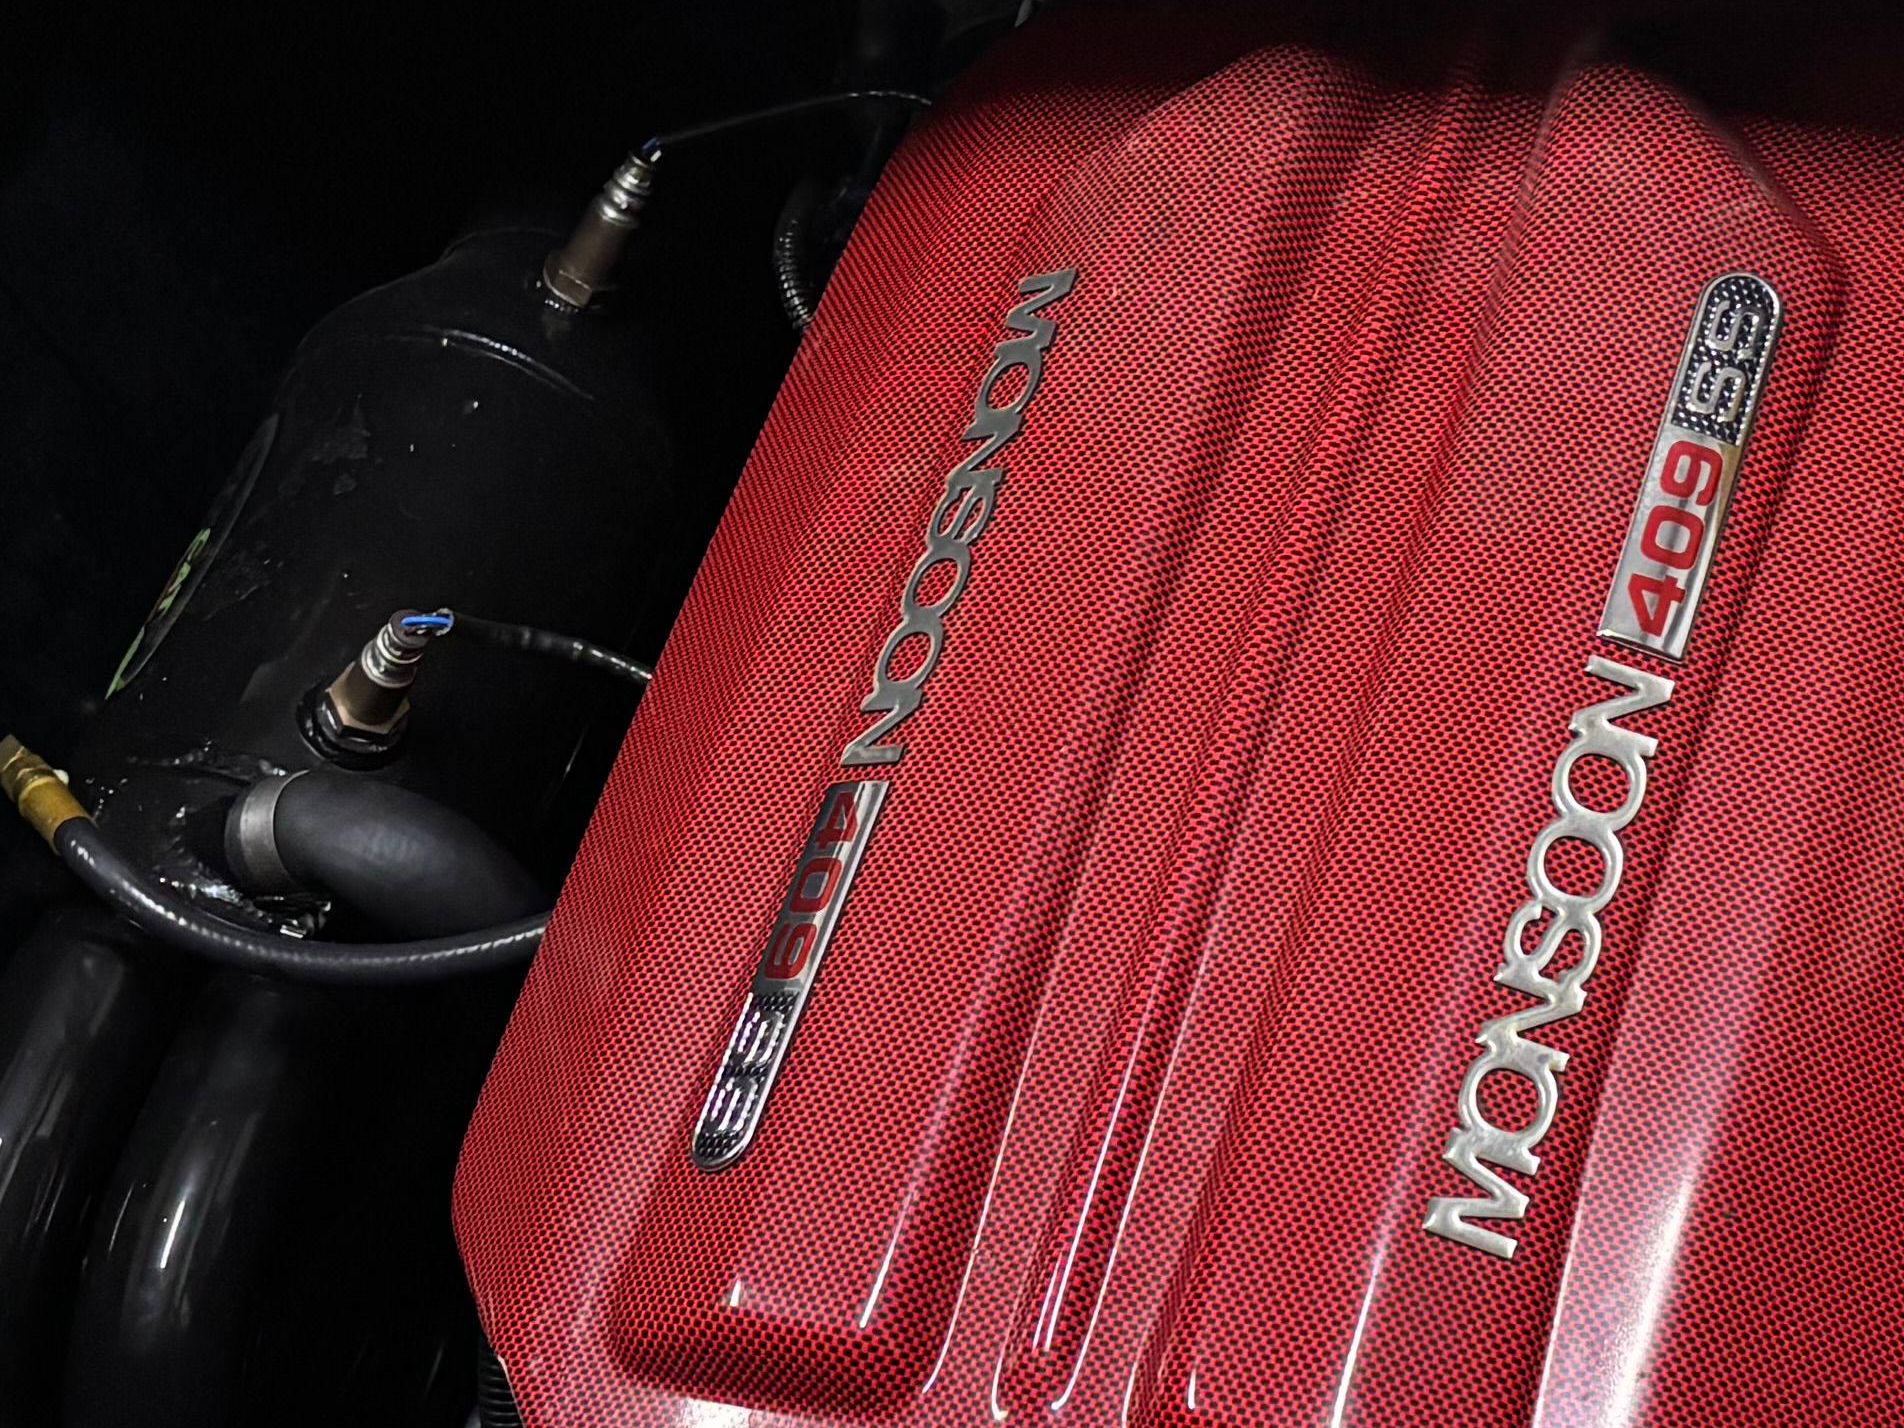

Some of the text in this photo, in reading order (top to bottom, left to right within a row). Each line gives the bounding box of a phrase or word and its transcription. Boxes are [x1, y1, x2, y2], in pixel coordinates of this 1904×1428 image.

[841, 264, 1077, 767] MONSOON
[762, 788, 856, 980] 409
[1422, 296, 1767, 1260] MONSOON 409 SS
